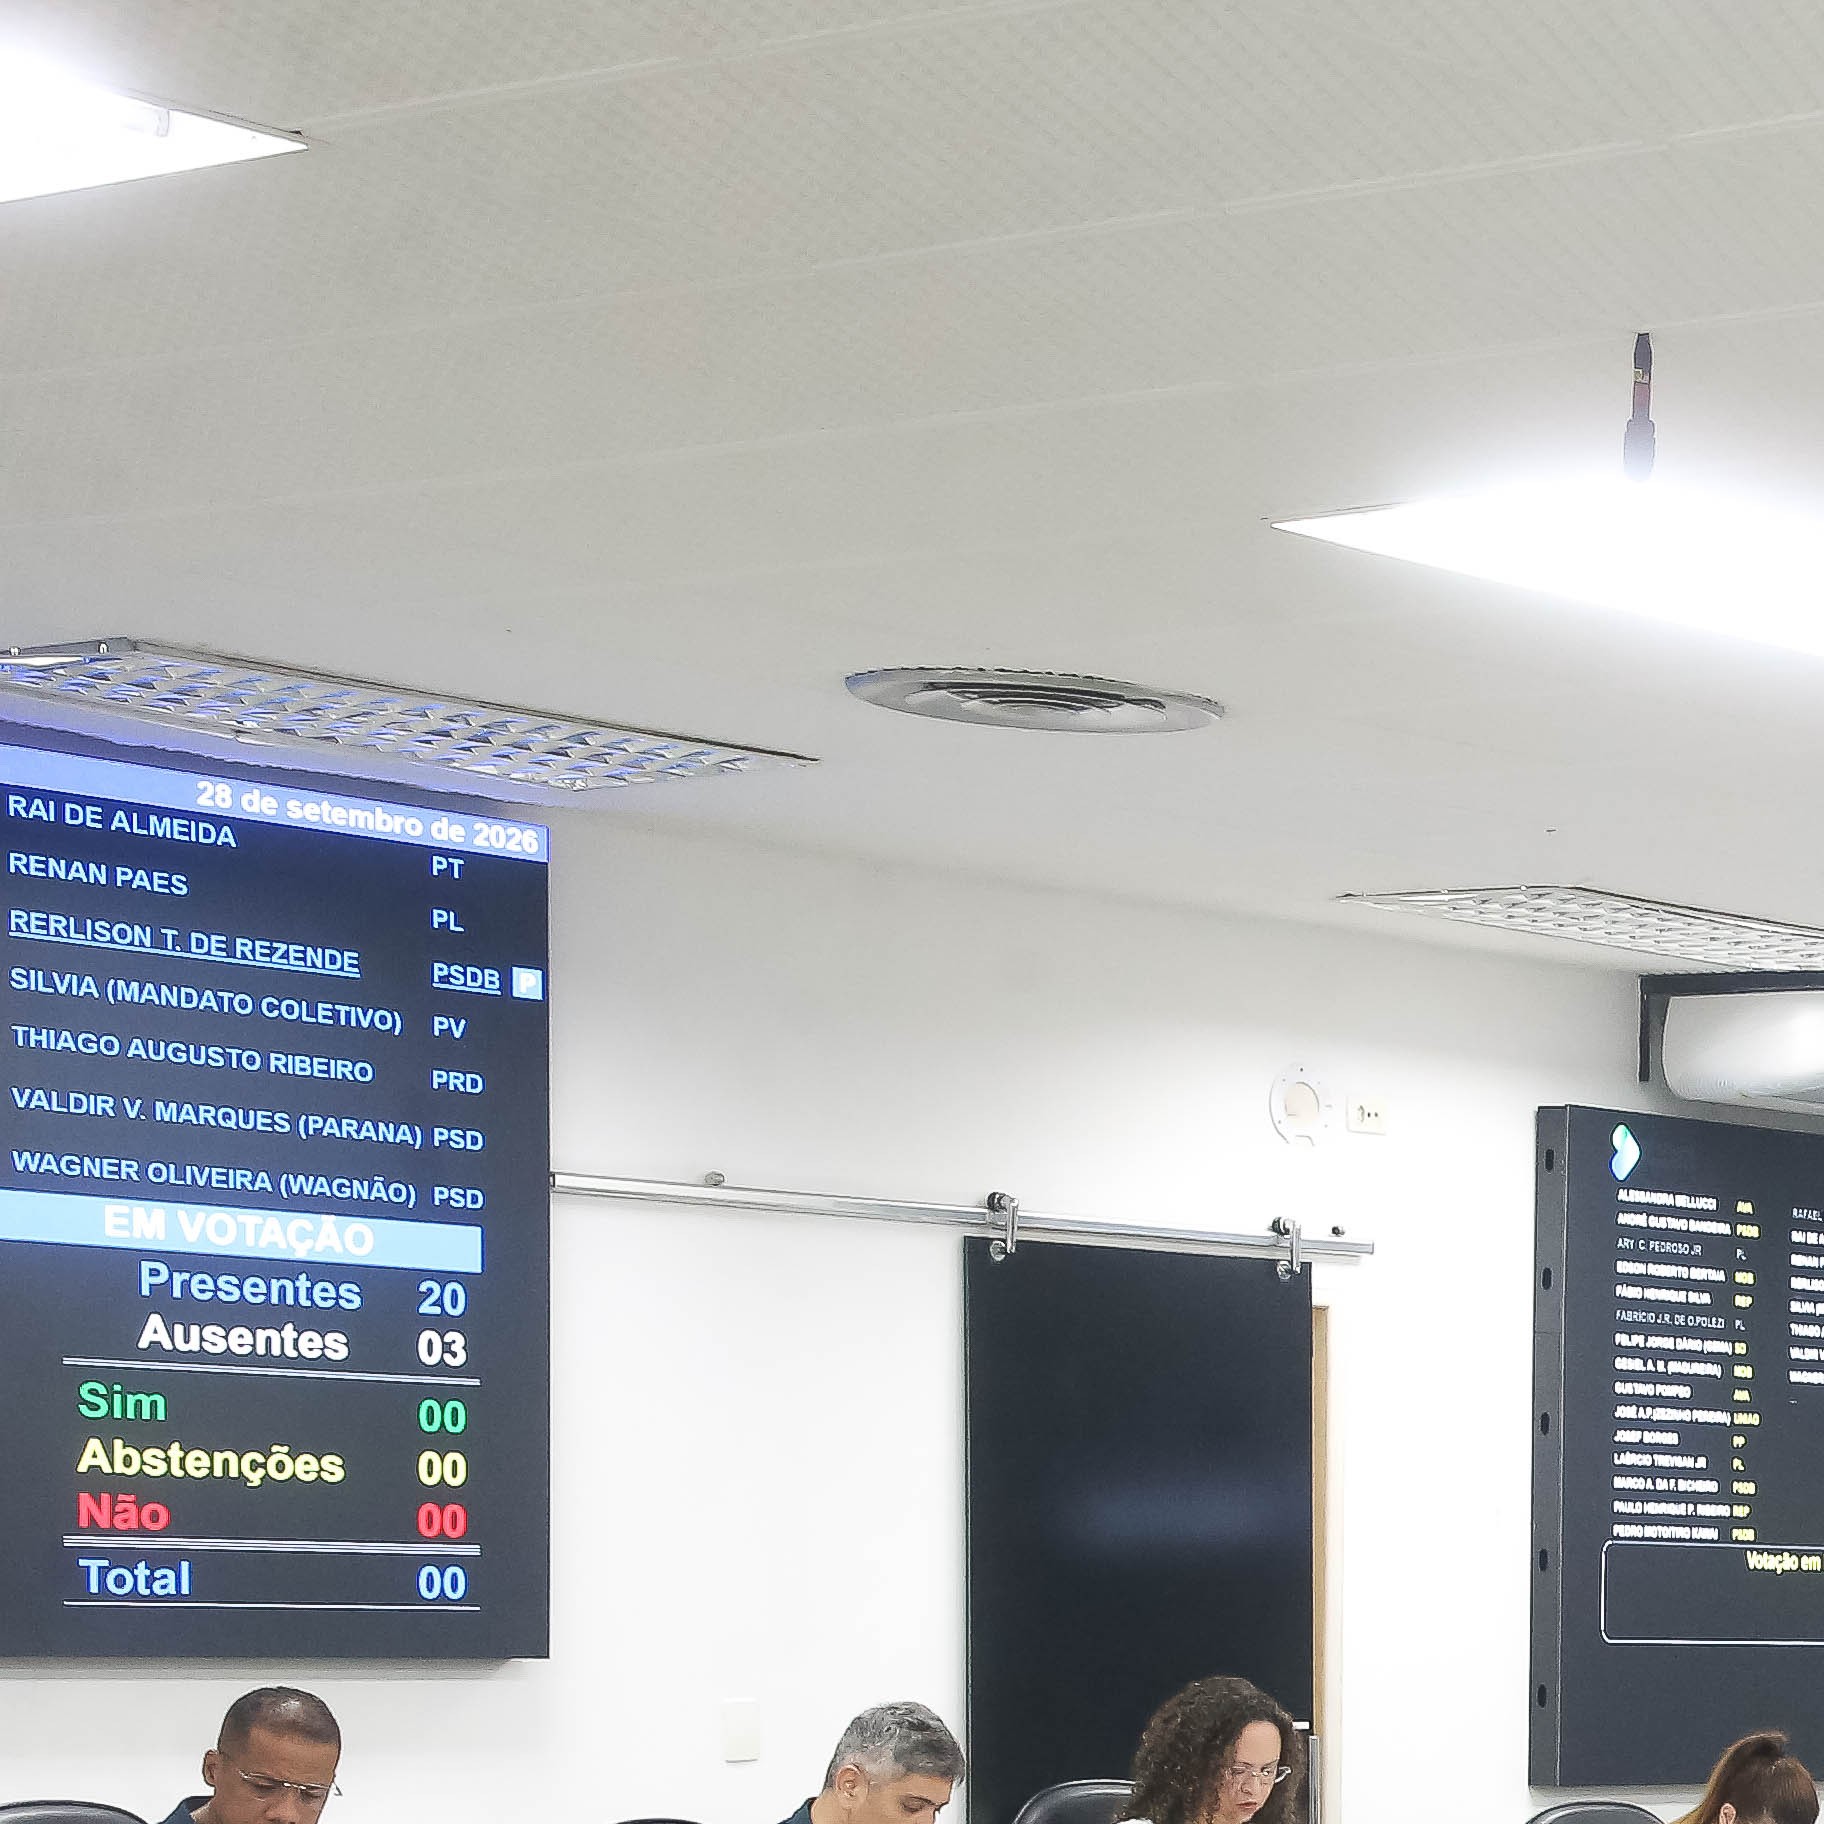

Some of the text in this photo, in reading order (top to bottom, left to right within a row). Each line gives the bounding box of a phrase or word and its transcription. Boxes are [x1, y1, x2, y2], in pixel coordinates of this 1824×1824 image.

[7, 794, 464, 880] RAI DE ALMEIDA PT
[197, 781, 539, 855] 28 de setembro de 2026
[9, 852, 464, 933] RENAN PAES PL
[9, 910, 536, 994] RERLISON T. DE REZENDE PSDB P
[9, 967, 466, 1040] SILVIA (MANDATO COLETIVO) PV
[12, 1025, 484, 1095] THIAGO AUGUSTO RIBEIRO PRD
[10, 1088, 484, 1152] VALDIR V. MARQUES (PARANA) PSD
[12, 1150, 484, 1210] WAGNER OLIVEIRA (WAGNÃO) PSD
[103, 1205, 374, 1258] EM VOTAÇÃO
[1617, 1237, 1634, 1251] ARY
[1649, 1239, 1691, 1255] PEDROSO
[140, 1261, 468, 1317] Presentes 20
[137, 1314, 468, 1367] Ausentes 03
[1674, 1314, 1685, 1328] DE
[77, 1382, 468, 1434] Sim 00
[76, 1438, 468, 1487] Abstenções 00
[77, 1493, 468, 1539] Não 00
[78, 1559, 468, 1600] Total 00
[1746, 1551, 1798, 1574] Votação
[1800, 1556, 1820, 1571] em
